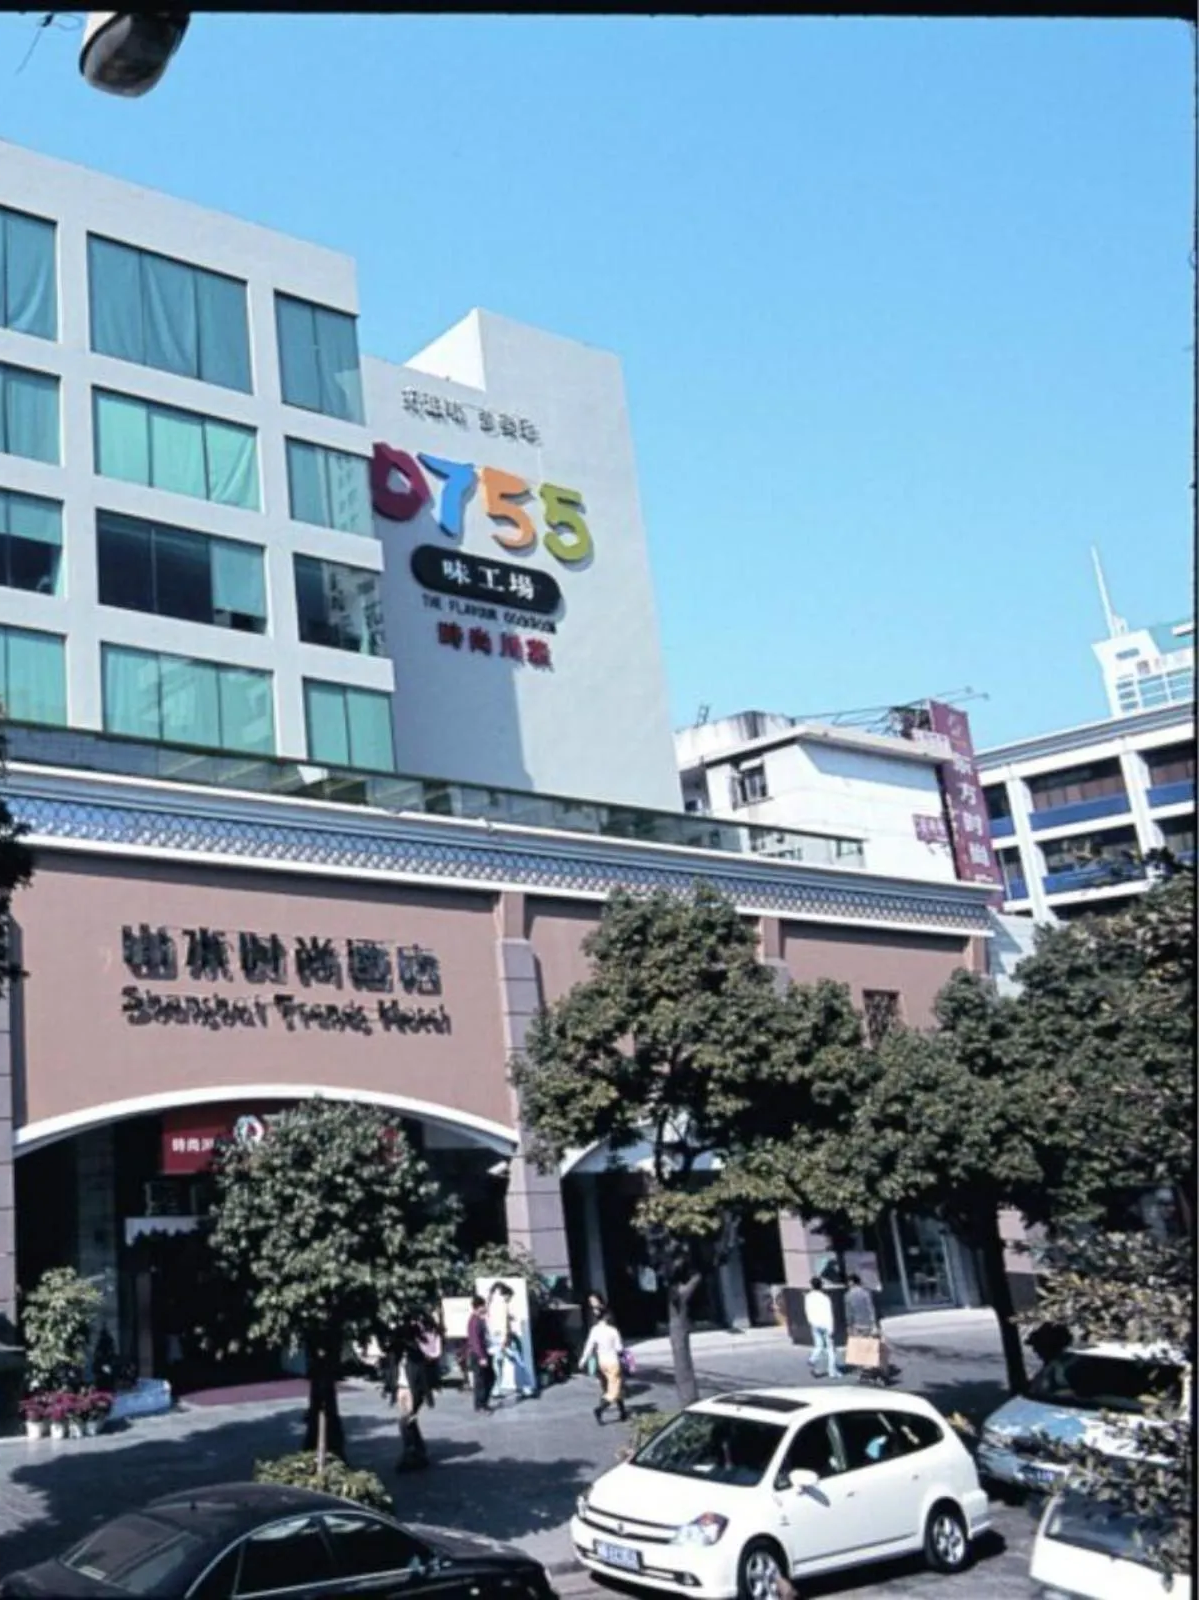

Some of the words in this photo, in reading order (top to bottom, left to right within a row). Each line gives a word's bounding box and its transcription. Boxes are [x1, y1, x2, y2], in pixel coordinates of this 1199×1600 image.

[371, 441, 591, 563] 0755
[441, 557, 536, 601] 味工場
